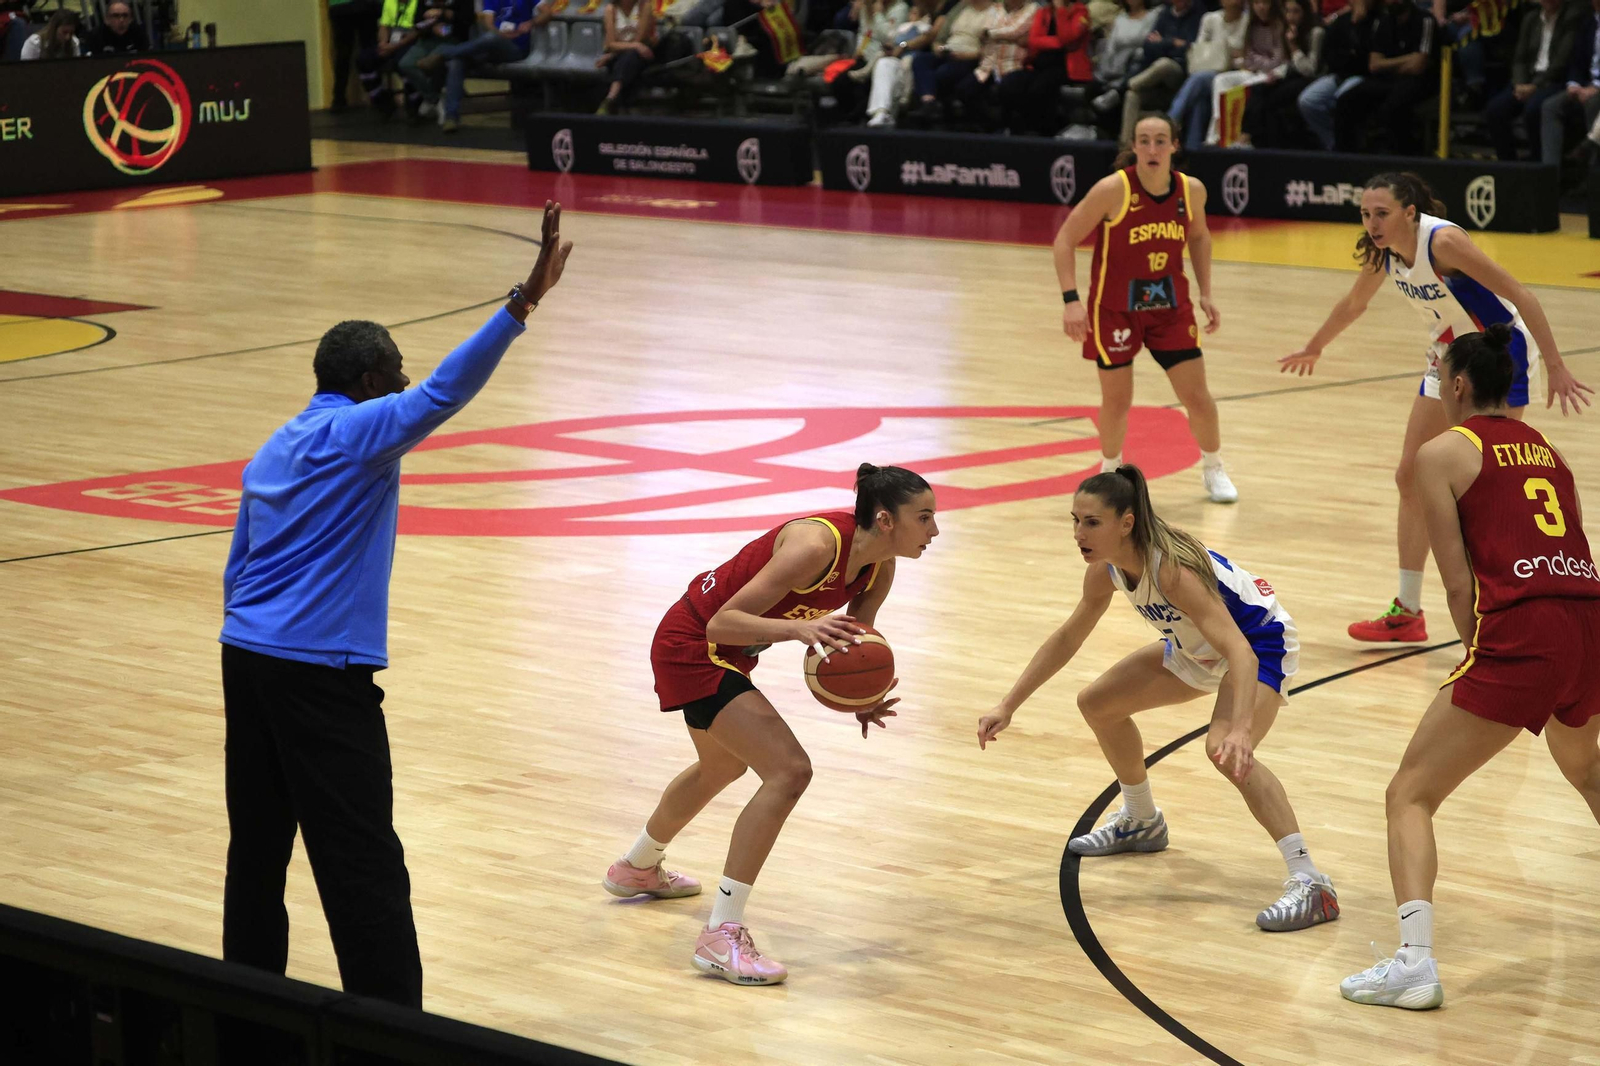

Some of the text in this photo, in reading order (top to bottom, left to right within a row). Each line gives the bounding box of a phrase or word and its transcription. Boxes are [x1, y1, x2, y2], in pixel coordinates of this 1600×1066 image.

[0, 117, 33, 141] ER
[901, 160, 1020, 188] #LaFamilia
[1285, 180, 1364, 207] #LaFa
[1129, 220, 1185, 245] ESPAÑA
[1395, 279, 1446, 301] FRANCE
[1492, 442, 1556, 468] ETXARRI
[1523, 477, 1567, 537] 3
